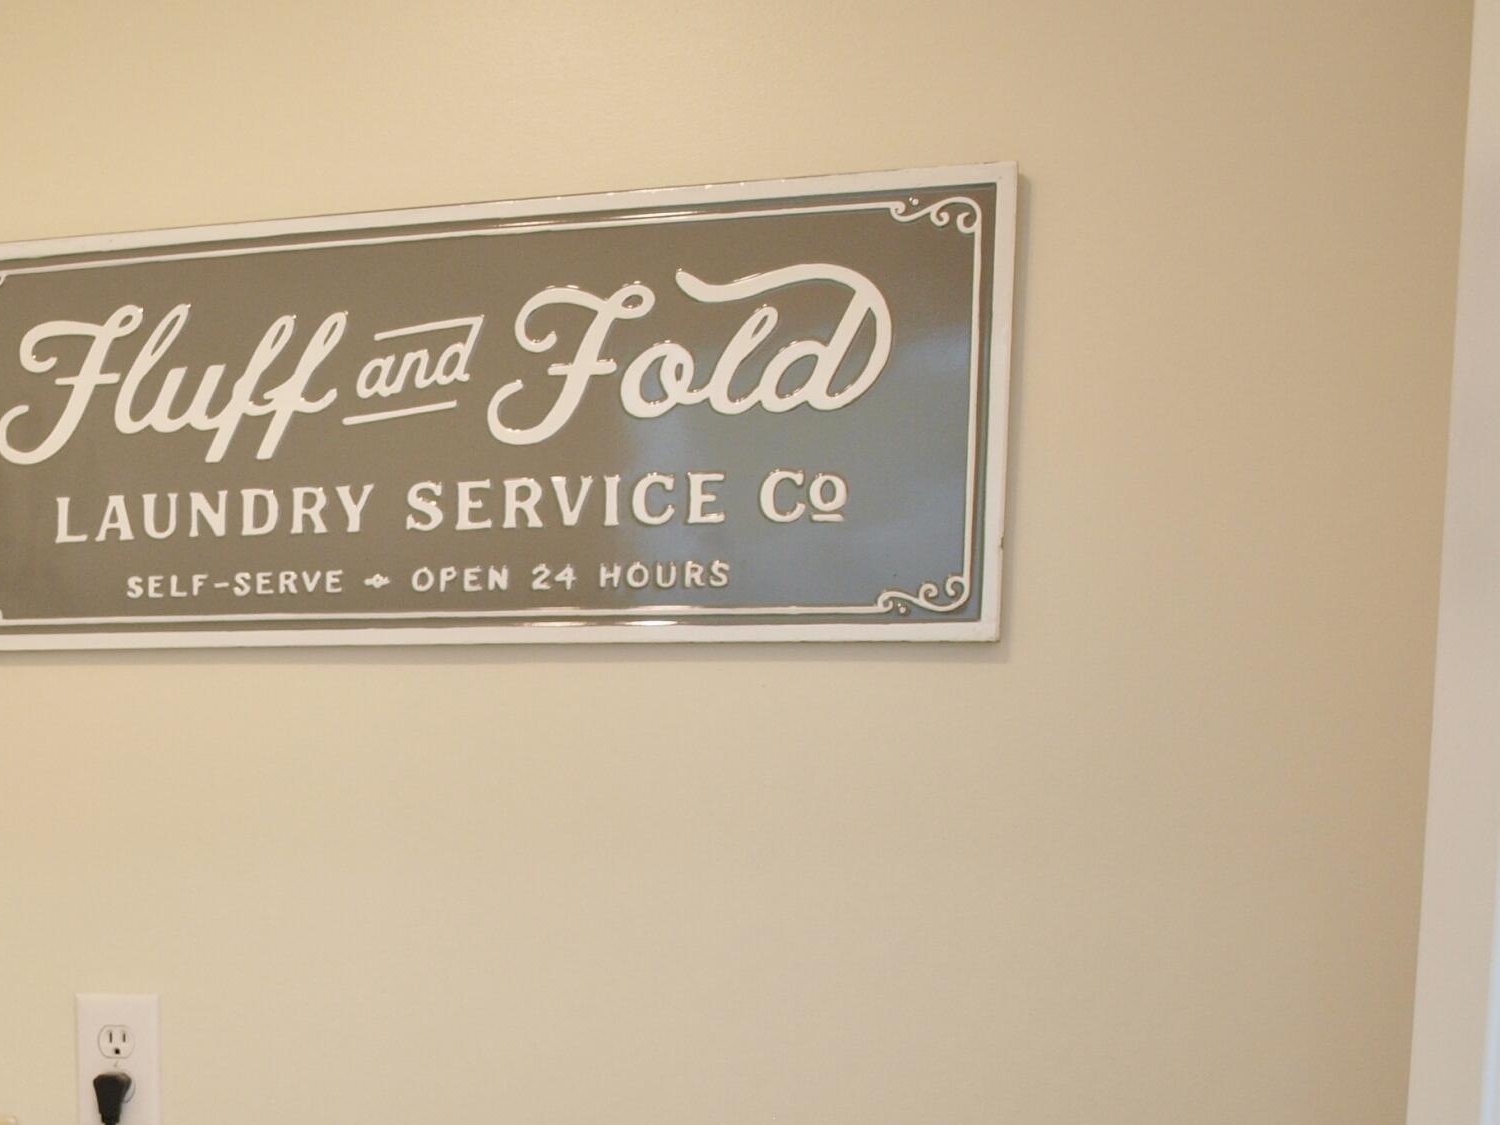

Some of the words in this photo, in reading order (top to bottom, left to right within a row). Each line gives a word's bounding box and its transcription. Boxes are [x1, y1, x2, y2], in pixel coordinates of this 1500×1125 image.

[356, 316, 482, 398] and
[488, 262, 892, 446] Fold
[56, 483, 375, 544] LAUNDRY
[406, 471, 728, 534] SERVICE
[126, 569, 344, 598] SELF-SERVE
[412, 565, 511, 594] OPEN
[531, 563, 578, 592] 24
[599, 560, 731, 590] HOURS
